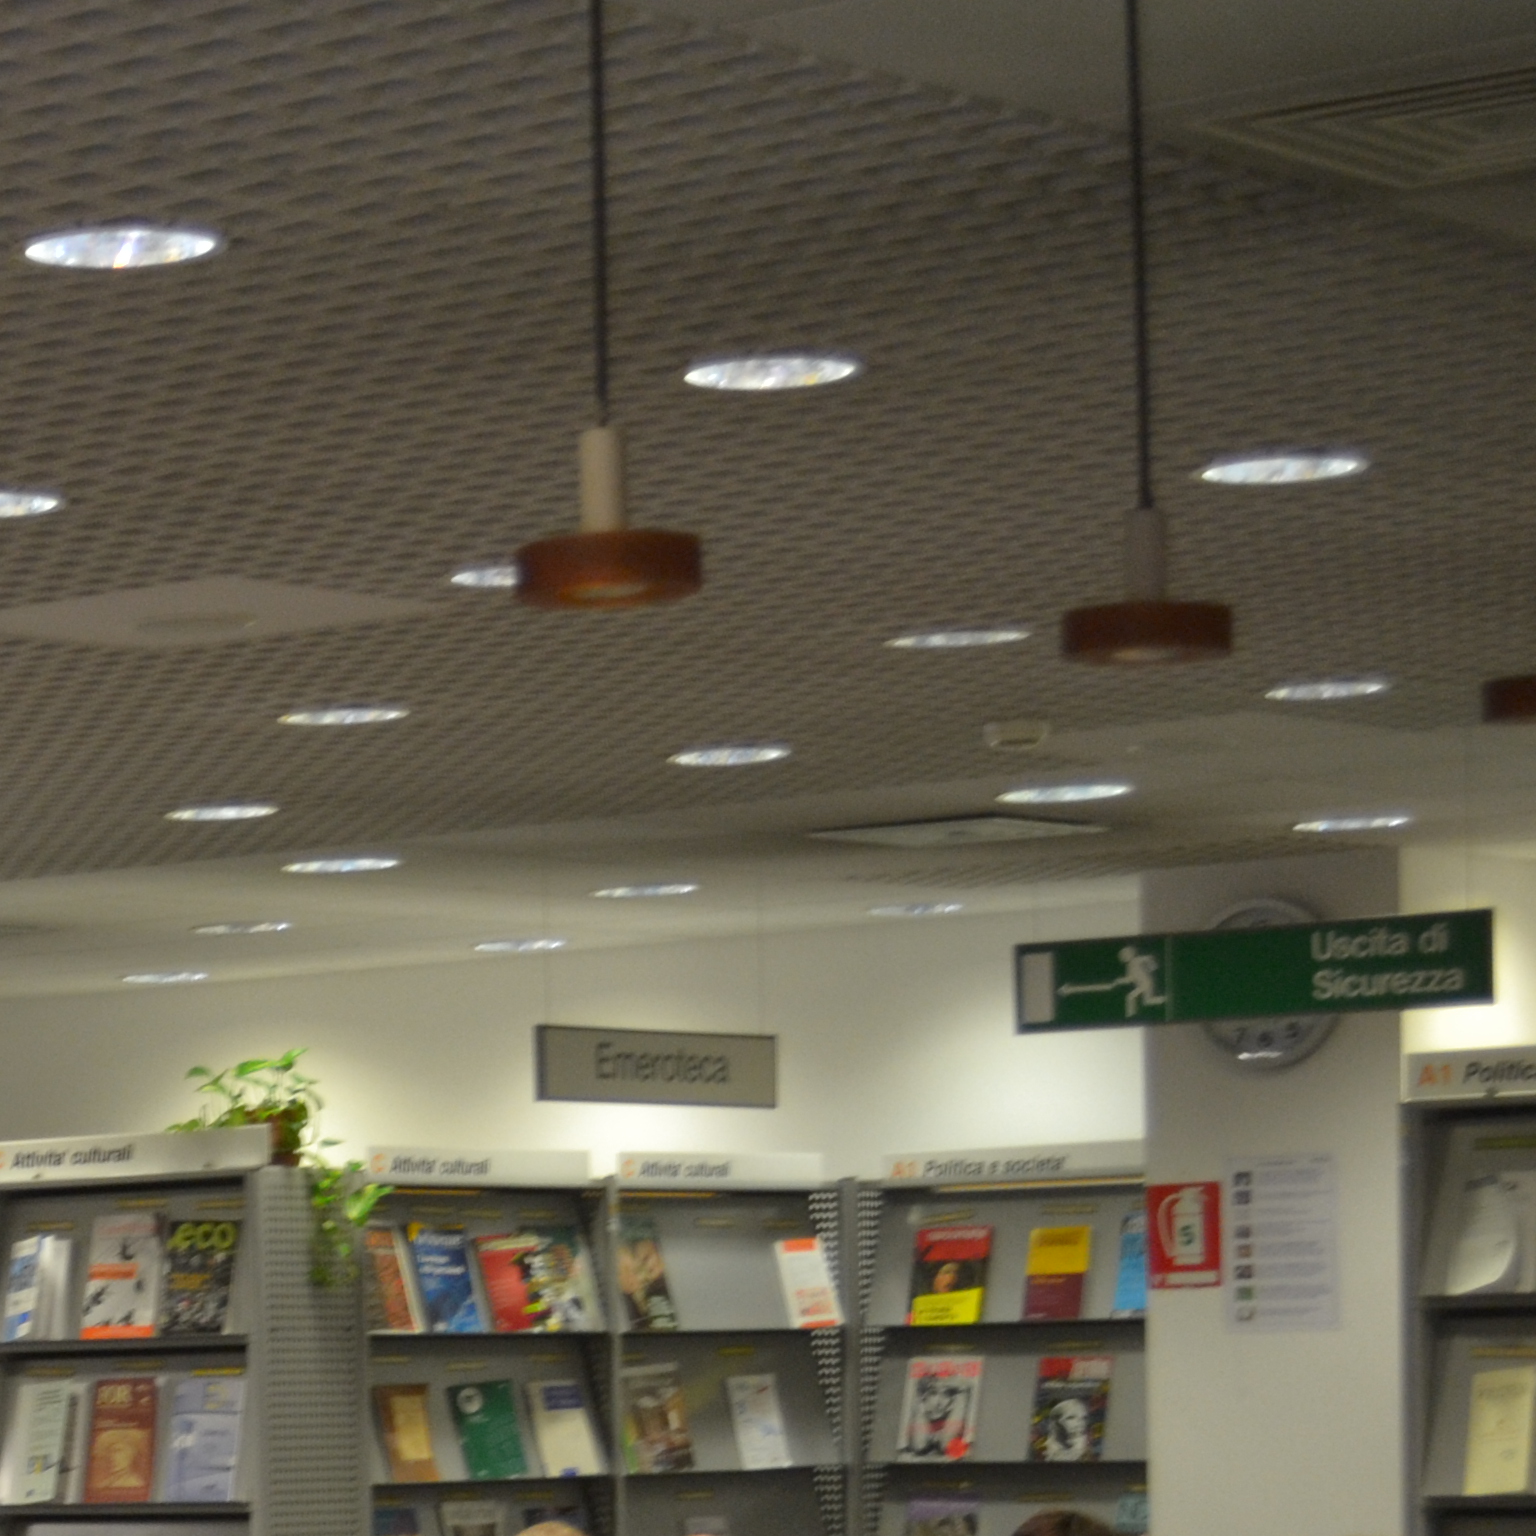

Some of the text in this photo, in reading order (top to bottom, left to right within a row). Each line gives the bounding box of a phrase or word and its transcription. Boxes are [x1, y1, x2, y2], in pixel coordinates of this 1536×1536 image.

[1310, 921, 1451, 963] Uscita di
[1311, 966, 1466, 1000] Sicurezza
[595, 1041, 729, 1084] Emeroteca
[1417, 1063, 1452, 1087] A1
[69, 1143, 134, 1166] culturali
[923, 1158, 983, 1178] Politica
